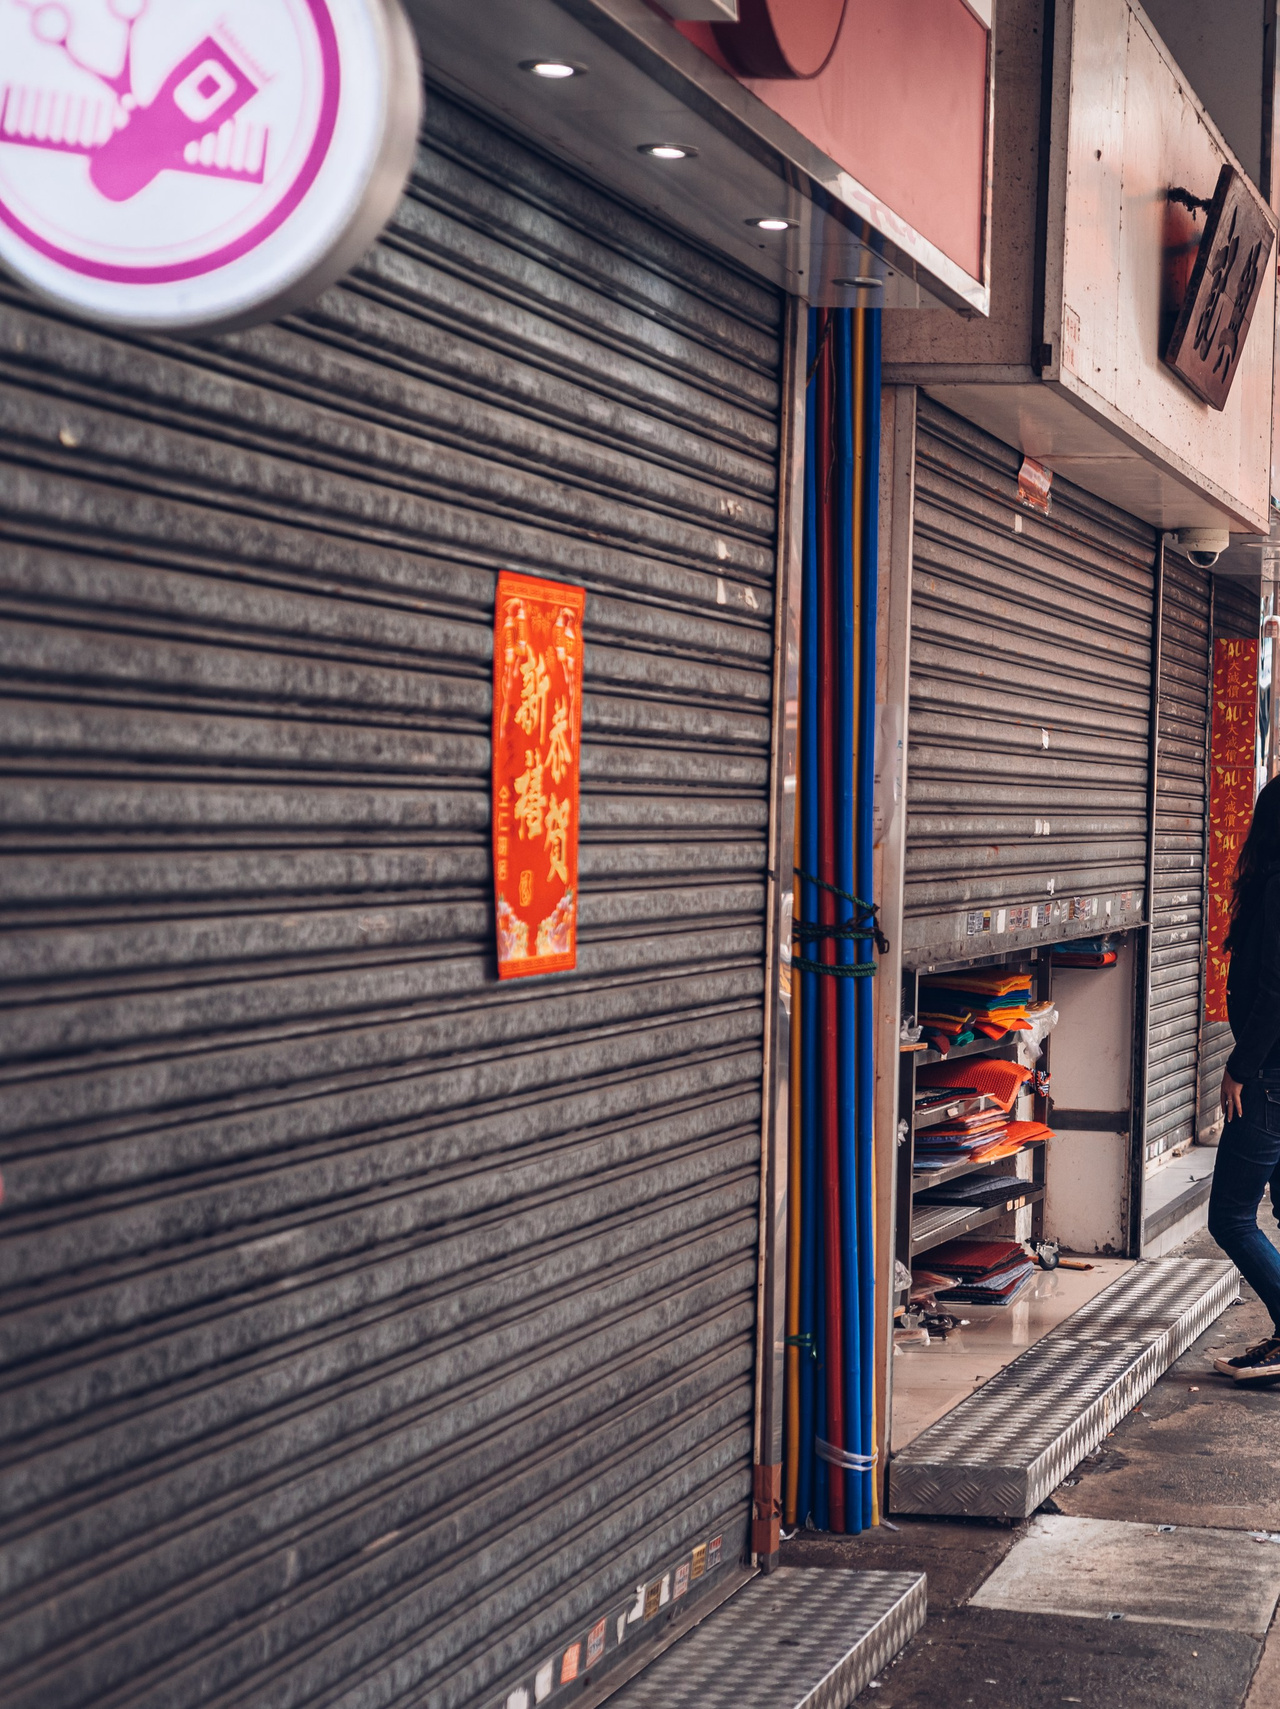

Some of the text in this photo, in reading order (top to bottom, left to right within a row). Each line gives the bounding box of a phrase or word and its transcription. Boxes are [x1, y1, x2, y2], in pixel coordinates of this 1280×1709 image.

[1227, 660, 1241, 698] 大減價
[1225, 724, 1239, 762] 大減價
[543, 696, 573, 885] 恭賀
[1223, 788, 1237, 827] 大減價
